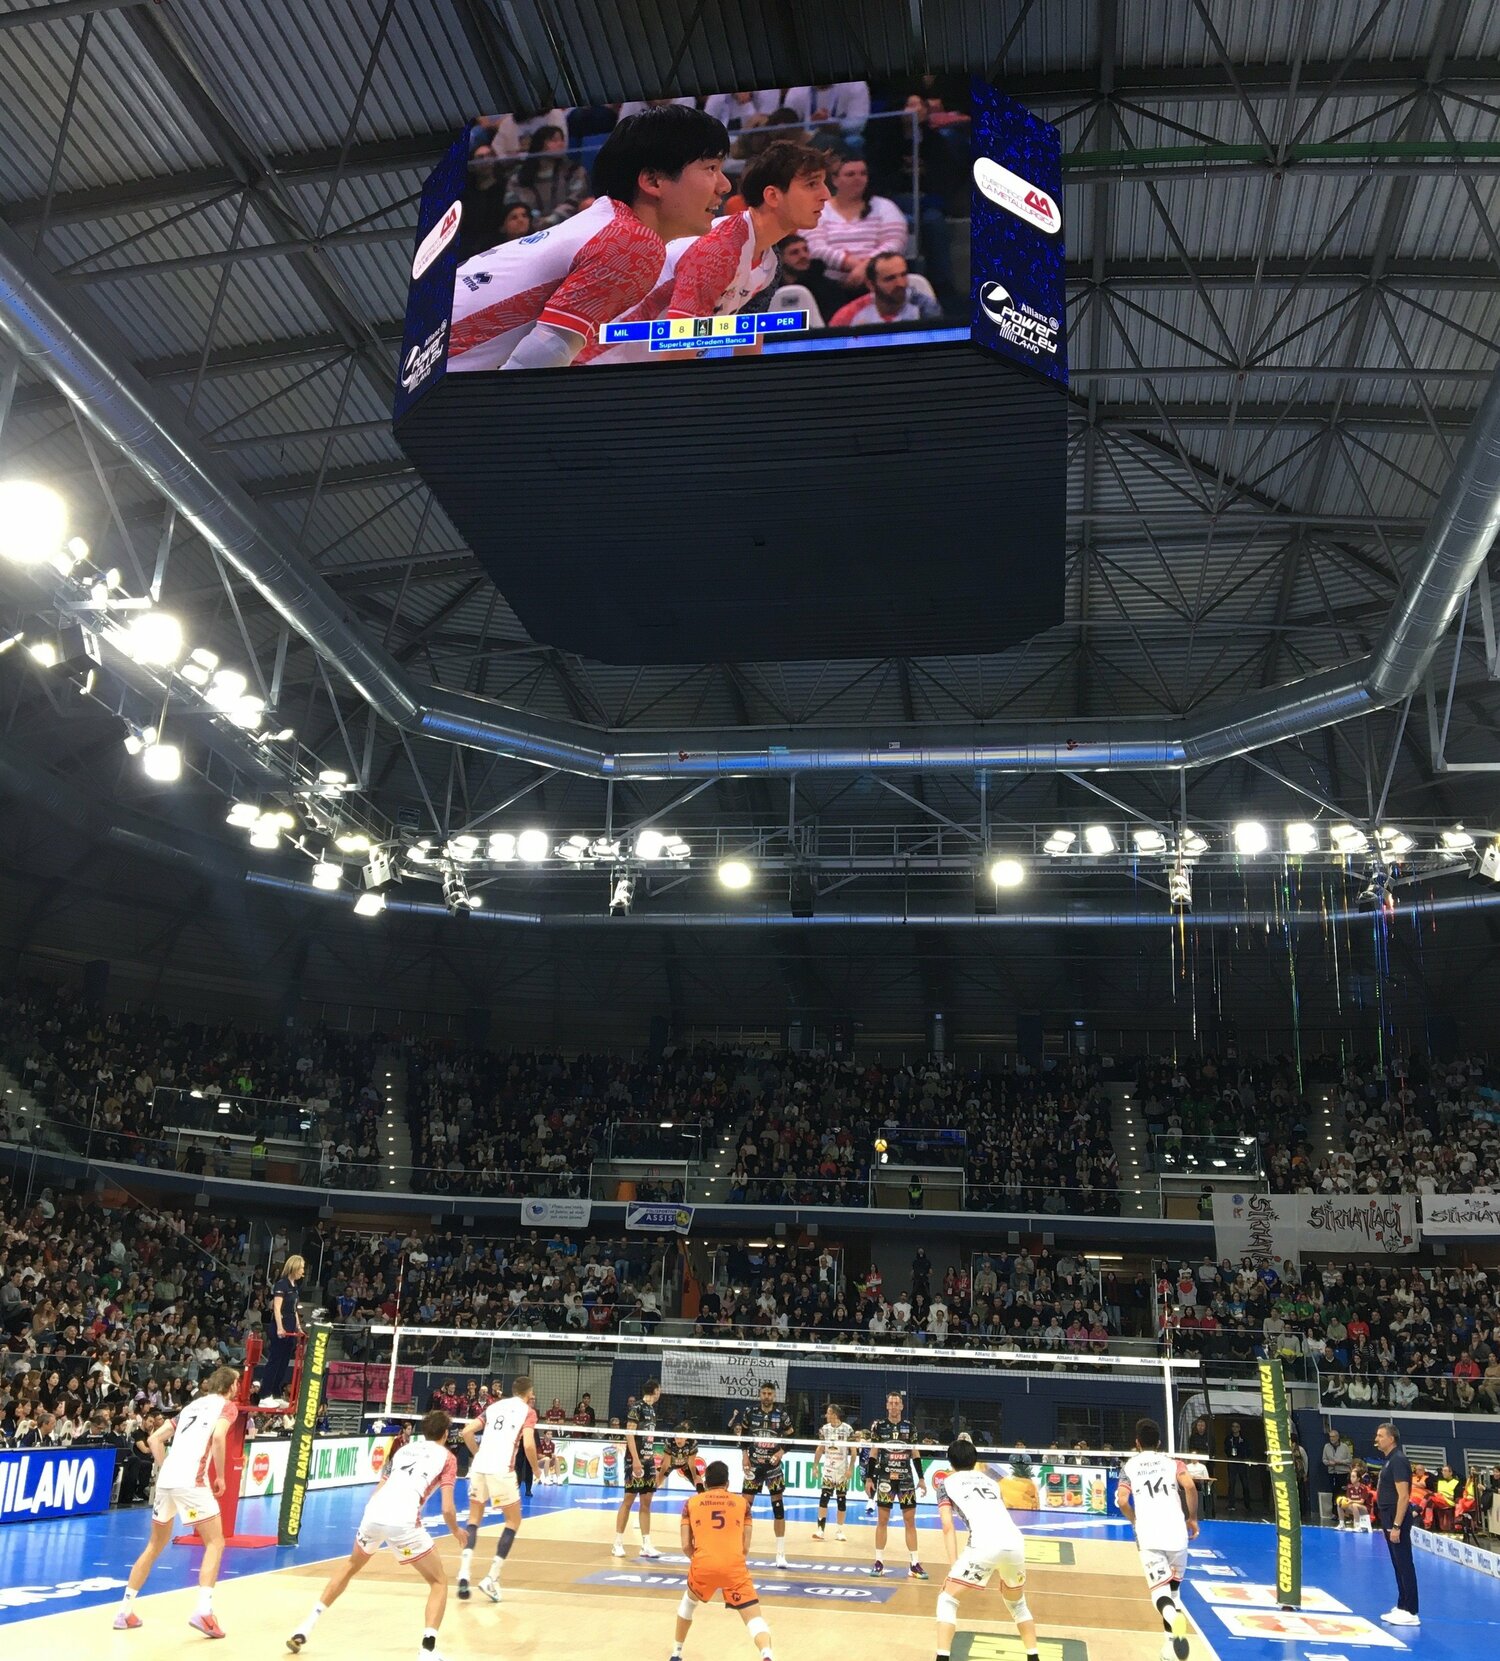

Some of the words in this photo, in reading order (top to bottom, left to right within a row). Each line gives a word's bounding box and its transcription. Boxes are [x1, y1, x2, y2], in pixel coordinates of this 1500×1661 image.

[462, 276, 480, 292] errea
[1021, 303, 1049, 324] Allianz
[614, 329, 629, 337] MIL
[657, 327, 664, 336] 0
[678, 325, 685, 334] 8
[720, 322, 729, 331] 18
[742, 321, 749, 329] 0
[777, 317, 794, 326] PER
[659, 340, 695, 349] SuperLega
[696, 338, 724, 346] Credem
[311, 1332, 329, 1375] BANCA
[728, 1357, 775, 1368] DIFESA
[746, 1368, 755, 1377] A
[1259, 1365, 1276, 1413] BANCA
[303, 1379, 321, 1428] CREDEM
[181, 1415, 198, 1434] 7
[494, 1415, 505, 1431] 8
[892, 1432, 899, 1440] 17
[1265, 1418, 1284, 1473] CREDEM
[295, 1434, 312, 1480] BANCA
[318, 1448, 332, 1479] DEL
[334, 1446, 359, 1477] MONTE
[973, 1487, 997, 1500] 15
[1144, 1477, 1169, 1498] 14
[287, 1484, 305, 1536] CREDEM
[1274, 1481, 1292, 1531] BANCA
[711, 1510, 726, 1530] 5
[1279, 1534, 1292, 1593] CREDEM
